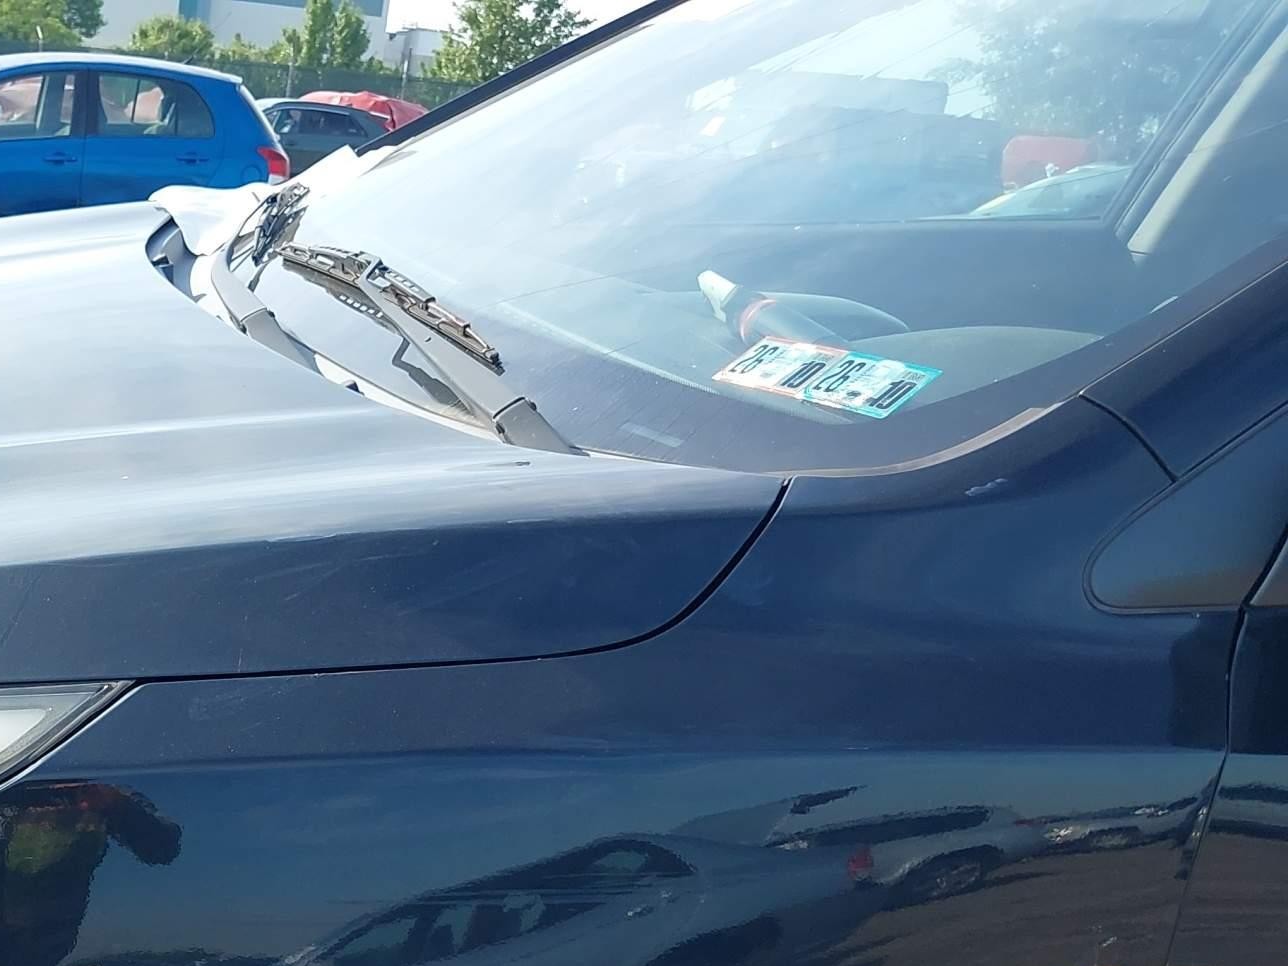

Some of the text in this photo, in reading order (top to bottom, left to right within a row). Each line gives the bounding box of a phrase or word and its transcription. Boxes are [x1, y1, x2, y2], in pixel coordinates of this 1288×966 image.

[729, 344, 779, 374] 26
[781, 360, 827, 389] 10
[812, 360, 867, 393] 26
[867, 379, 918, 410] 10
